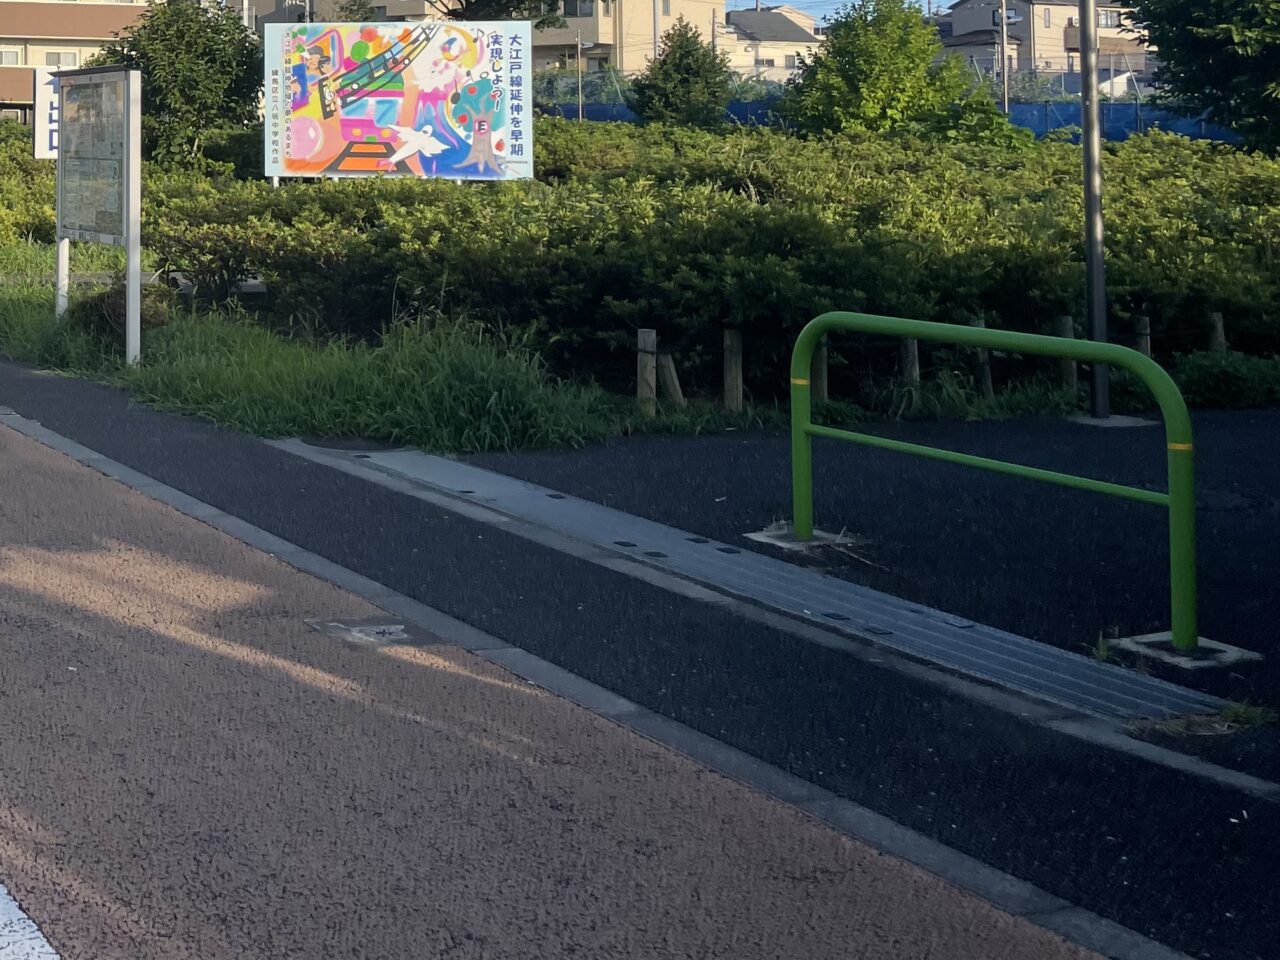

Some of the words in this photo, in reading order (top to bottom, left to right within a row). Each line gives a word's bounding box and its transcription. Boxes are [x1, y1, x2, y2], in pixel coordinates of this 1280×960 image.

[477, 120, 486, 132] E
[509, 33, 524, 156] 大江戸線延伸を早期
